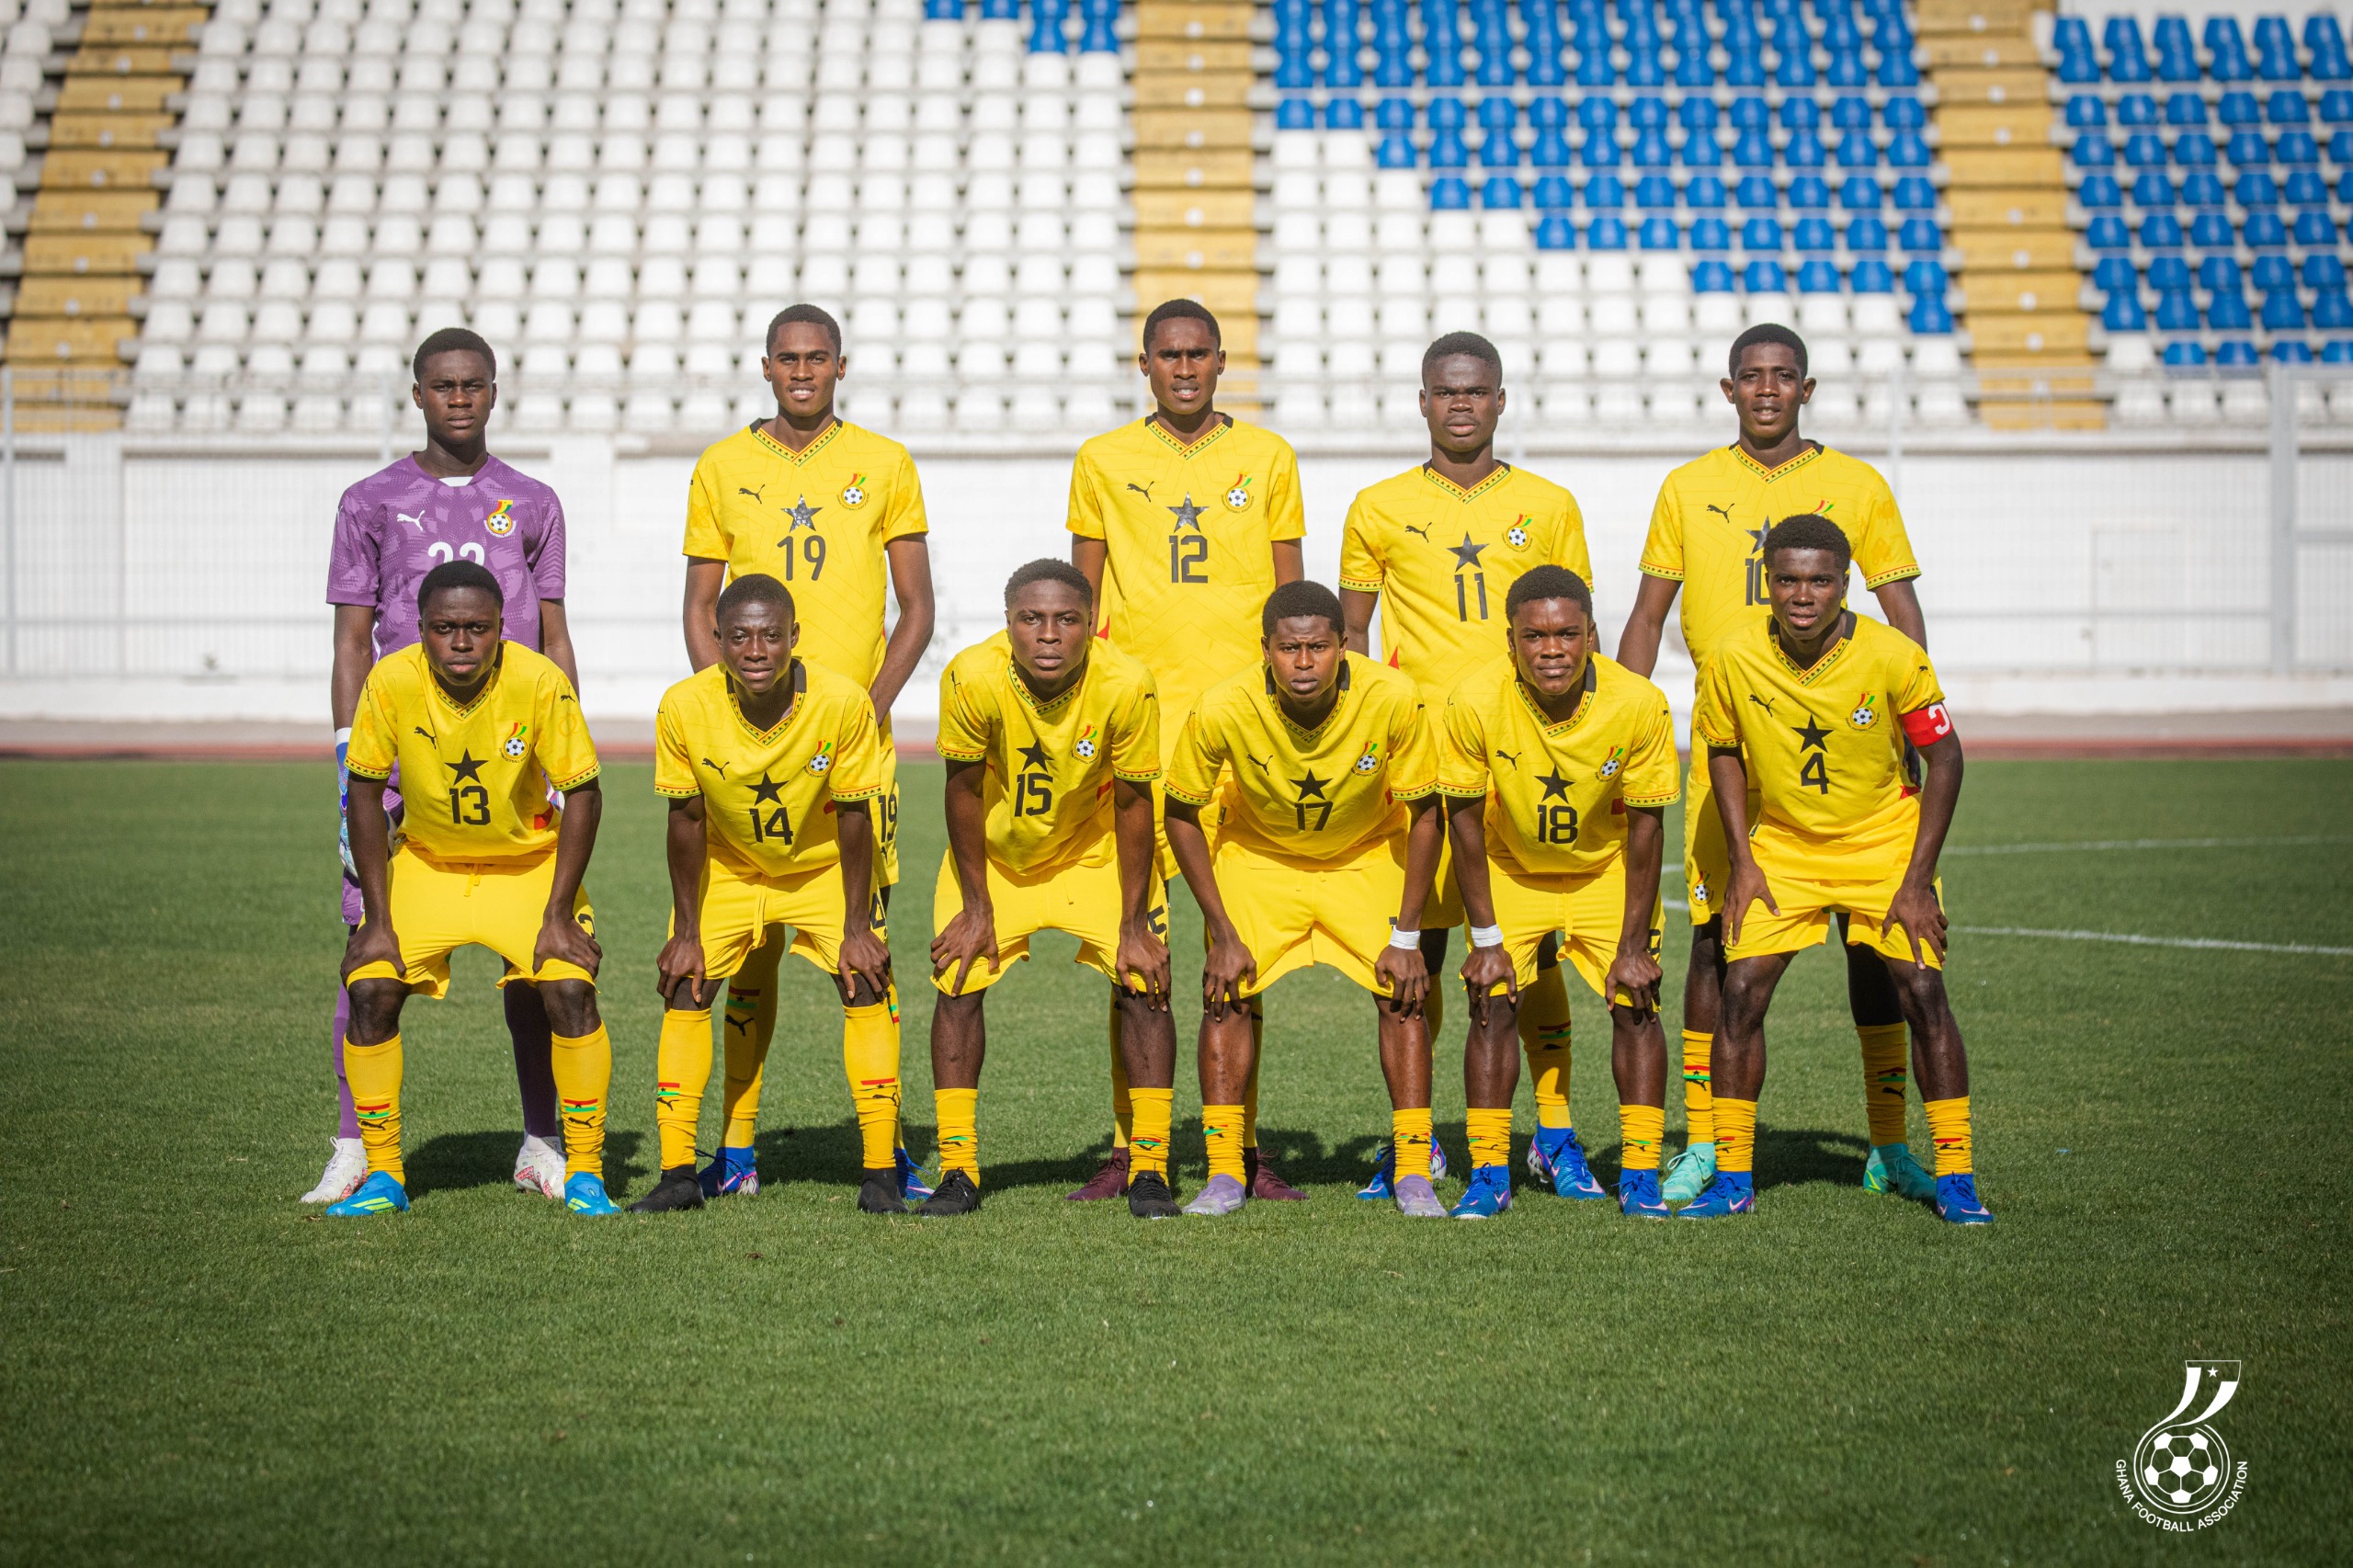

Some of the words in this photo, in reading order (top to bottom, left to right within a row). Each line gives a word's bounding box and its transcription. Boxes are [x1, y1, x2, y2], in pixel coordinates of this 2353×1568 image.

[777, 535, 826, 581] 19
[1168, 535, 1208, 583] 12
[1454, 572, 1488, 622] 11
[1014, 772, 1053, 817] 15
[1801, 752, 1829, 795] 4
[449, 785, 491, 825] 13
[749, 806, 794, 845] 14
[878, 793, 898, 843] 19
[1294, 801, 1334, 832] 17
[1537, 803, 1578, 844] 18
